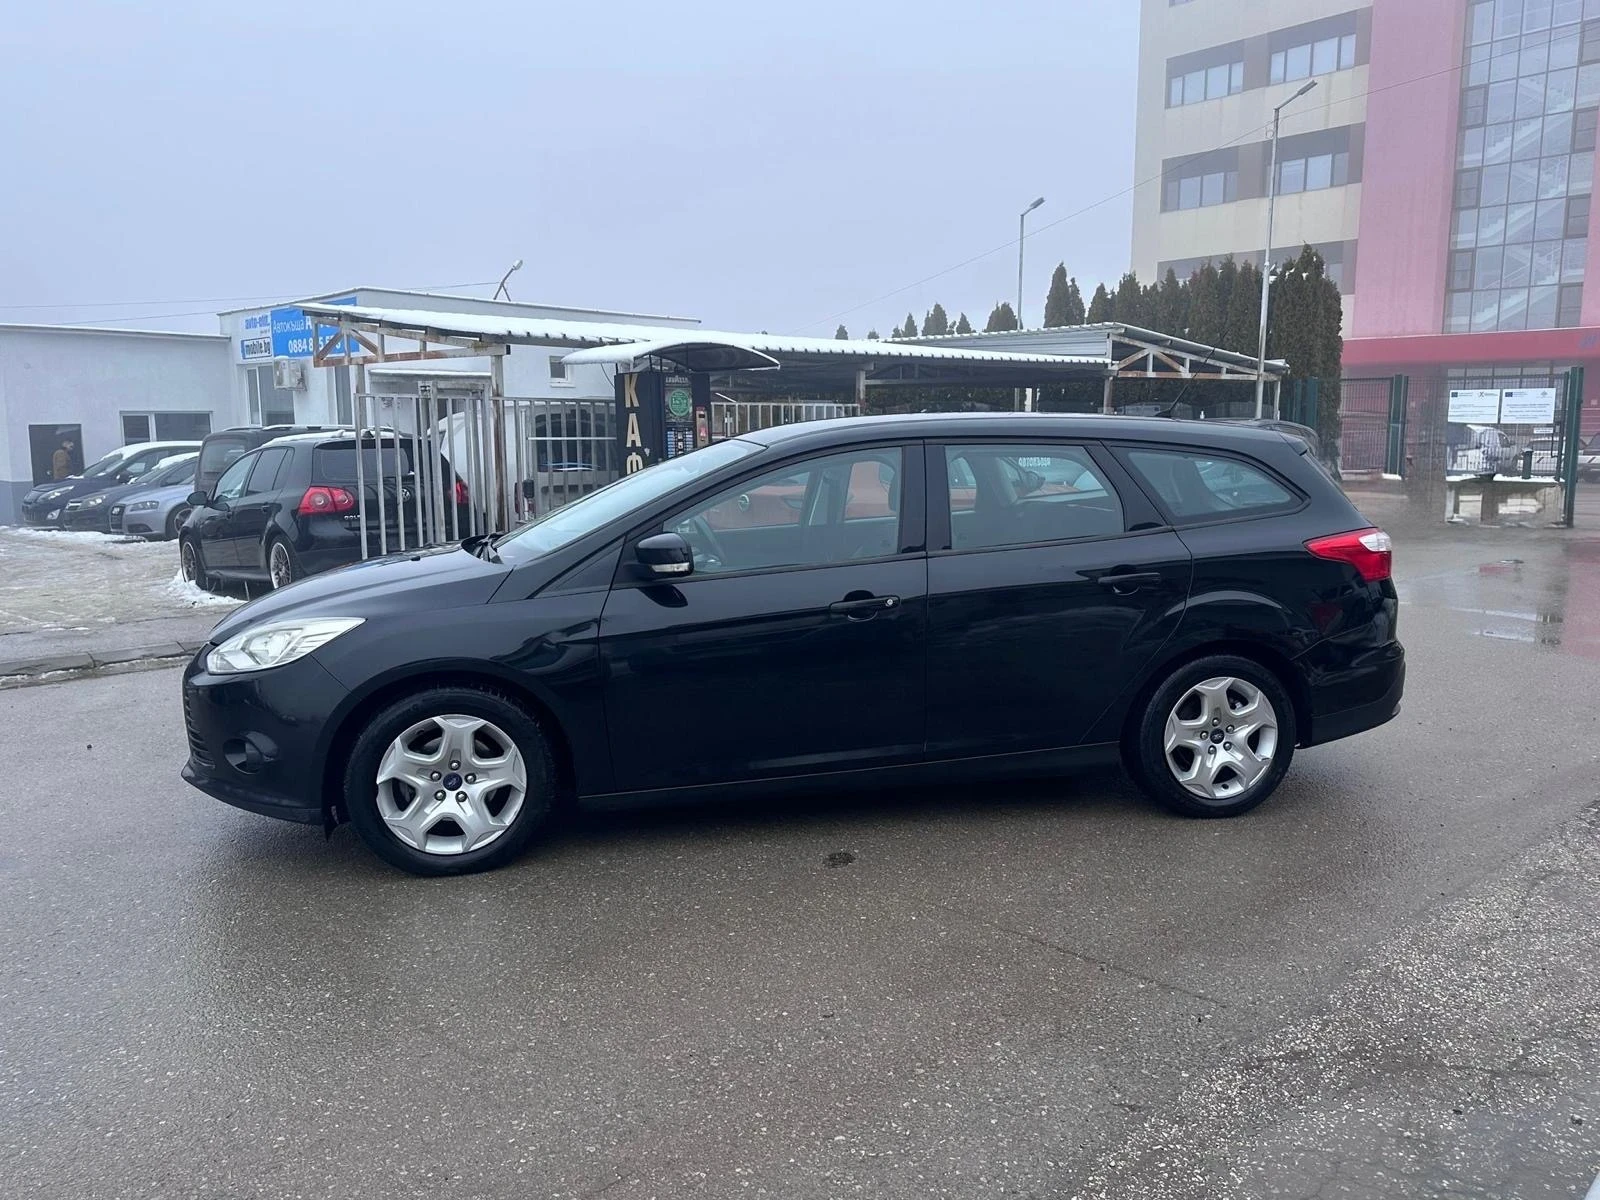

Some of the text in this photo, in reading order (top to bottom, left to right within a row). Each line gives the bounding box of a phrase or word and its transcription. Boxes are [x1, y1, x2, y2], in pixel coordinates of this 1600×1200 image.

[272, 319, 305, 334] Автокъща
[245, 340, 270, 356] mobile.bg
[288, 338, 307, 353] 0884
[309, 336, 324, 351] 85
